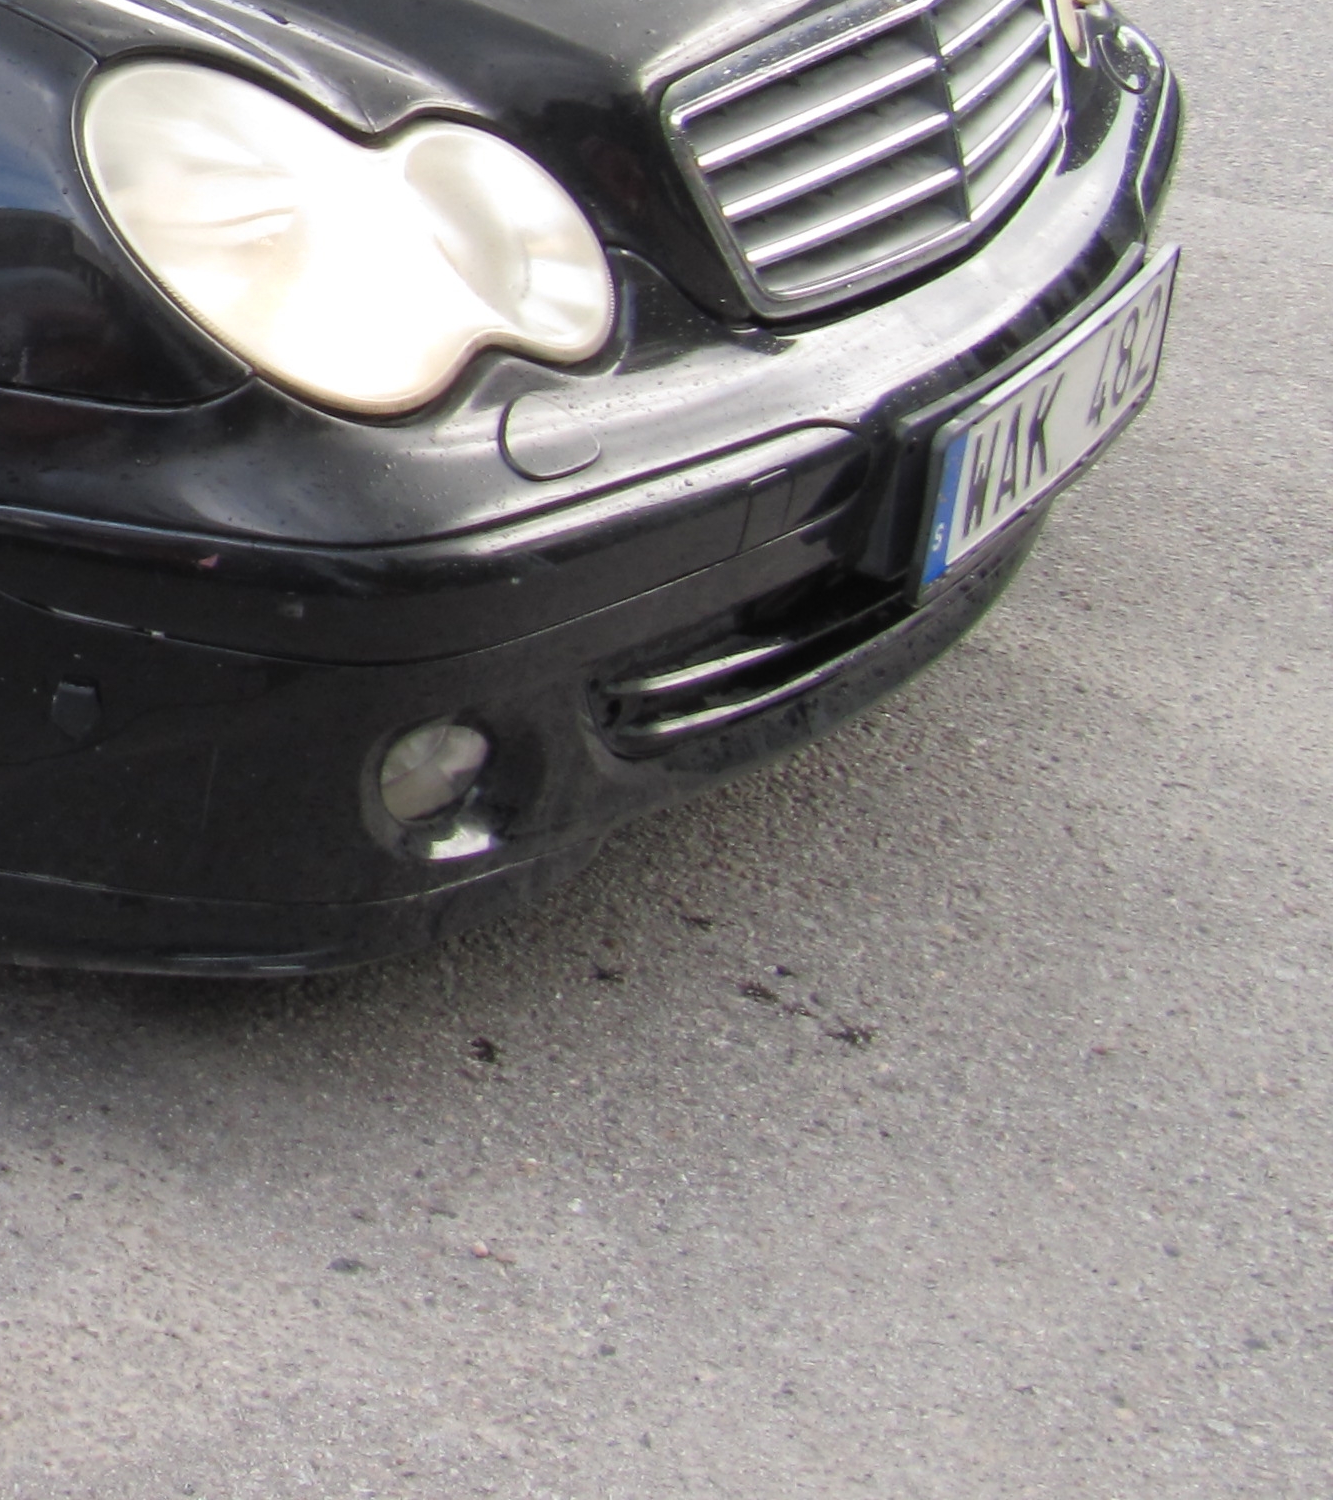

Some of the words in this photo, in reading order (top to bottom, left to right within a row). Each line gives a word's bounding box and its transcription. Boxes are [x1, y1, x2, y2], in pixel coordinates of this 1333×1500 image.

[962, 373, 1064, 539] WAK
[1086, 284, 1162, 427] 482
[933, 524, 944, 551] S
